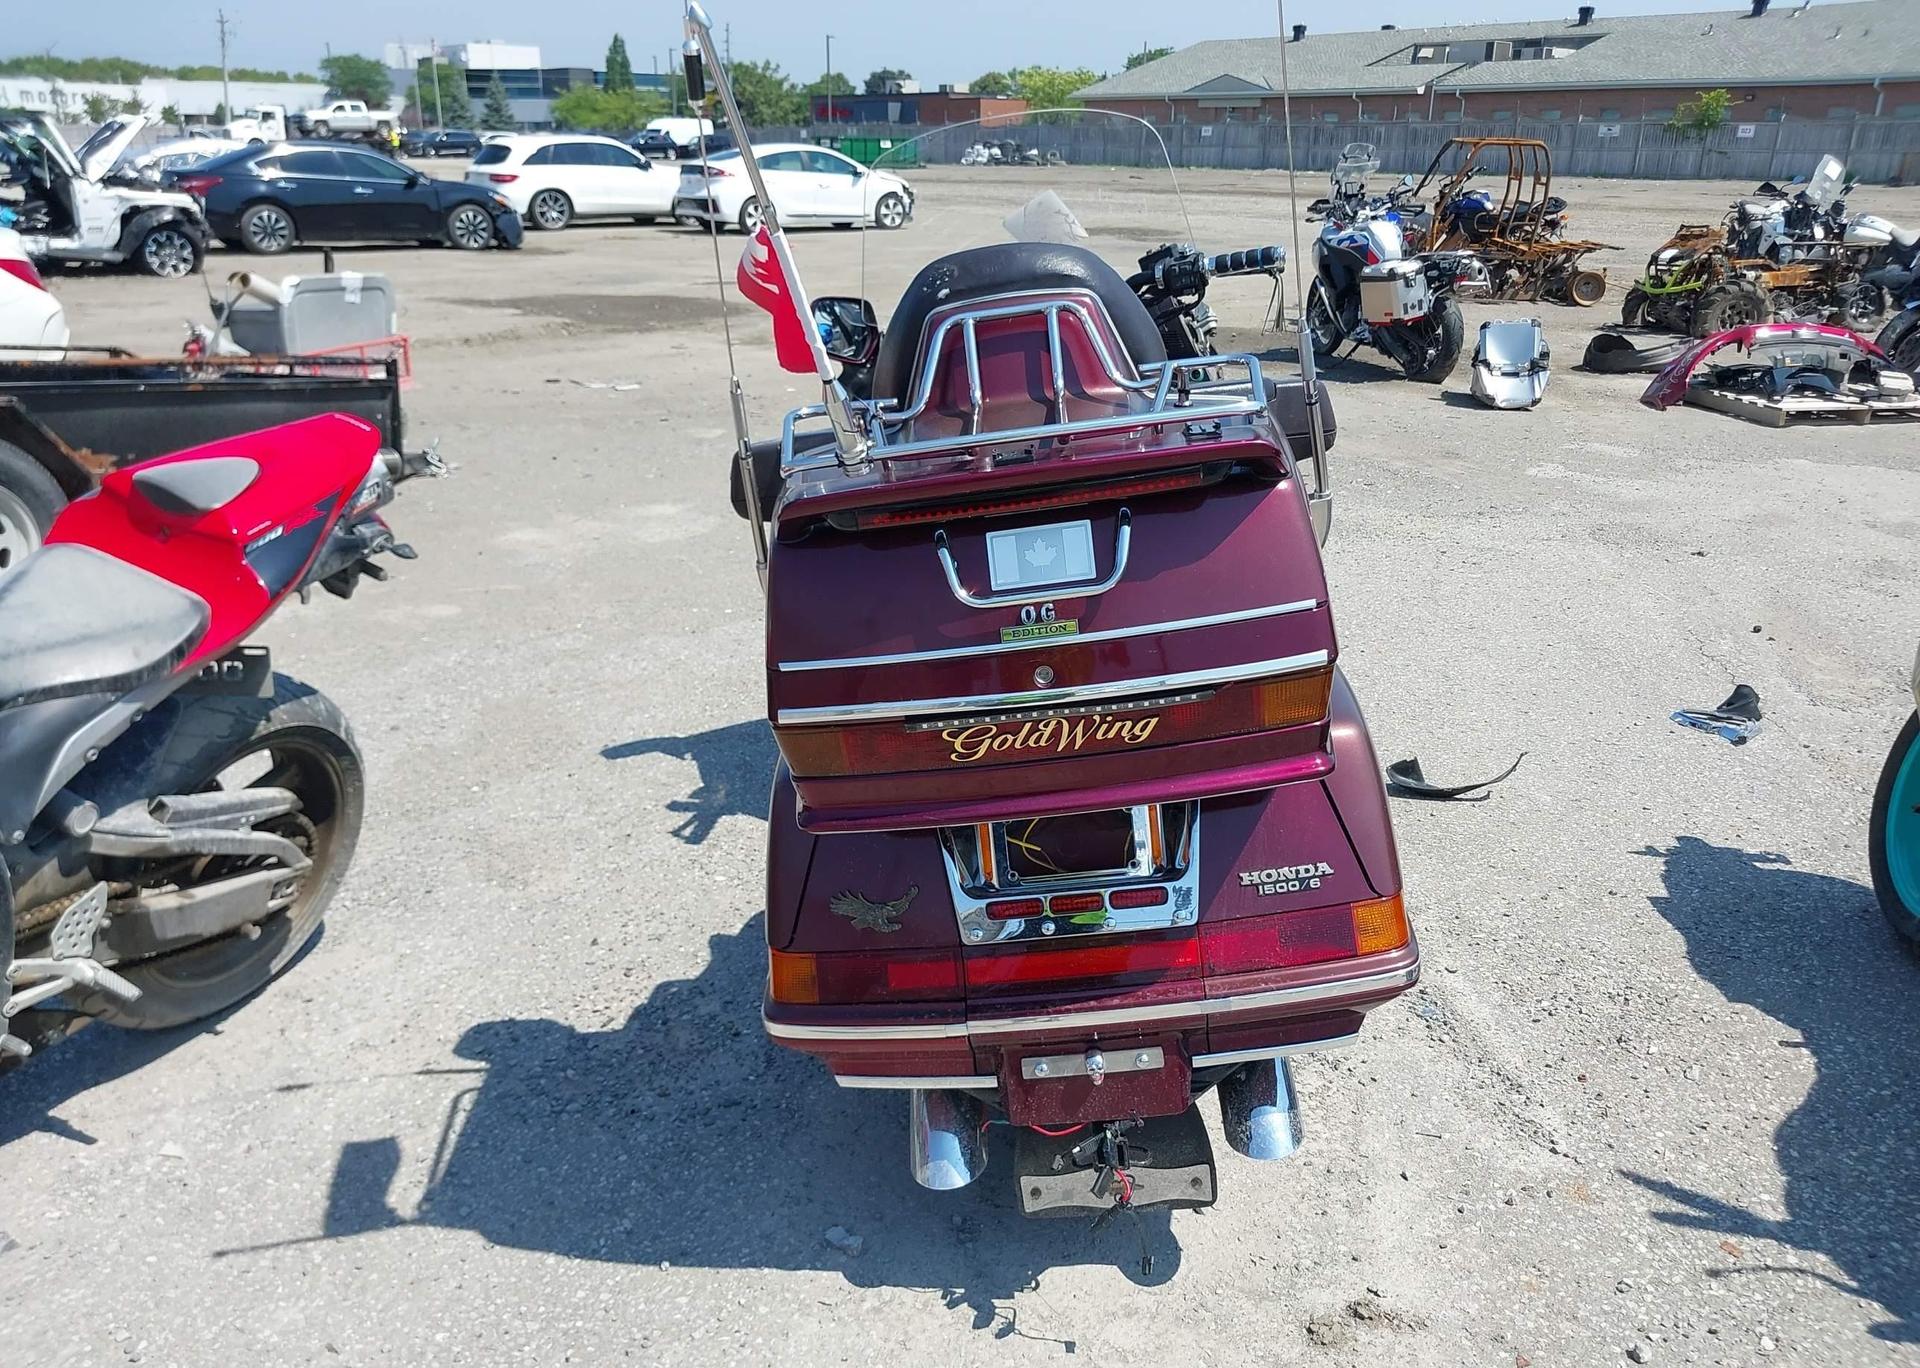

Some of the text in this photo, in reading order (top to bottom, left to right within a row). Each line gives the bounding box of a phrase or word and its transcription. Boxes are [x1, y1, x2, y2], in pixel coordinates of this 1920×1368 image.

[1020, 602, 1056, 625] OG
[1010, 623, 1069, 638] EDITION
[1239, 862, 1335, 886] HONDA
[1257, 878, 1321, 896] 1500/6
